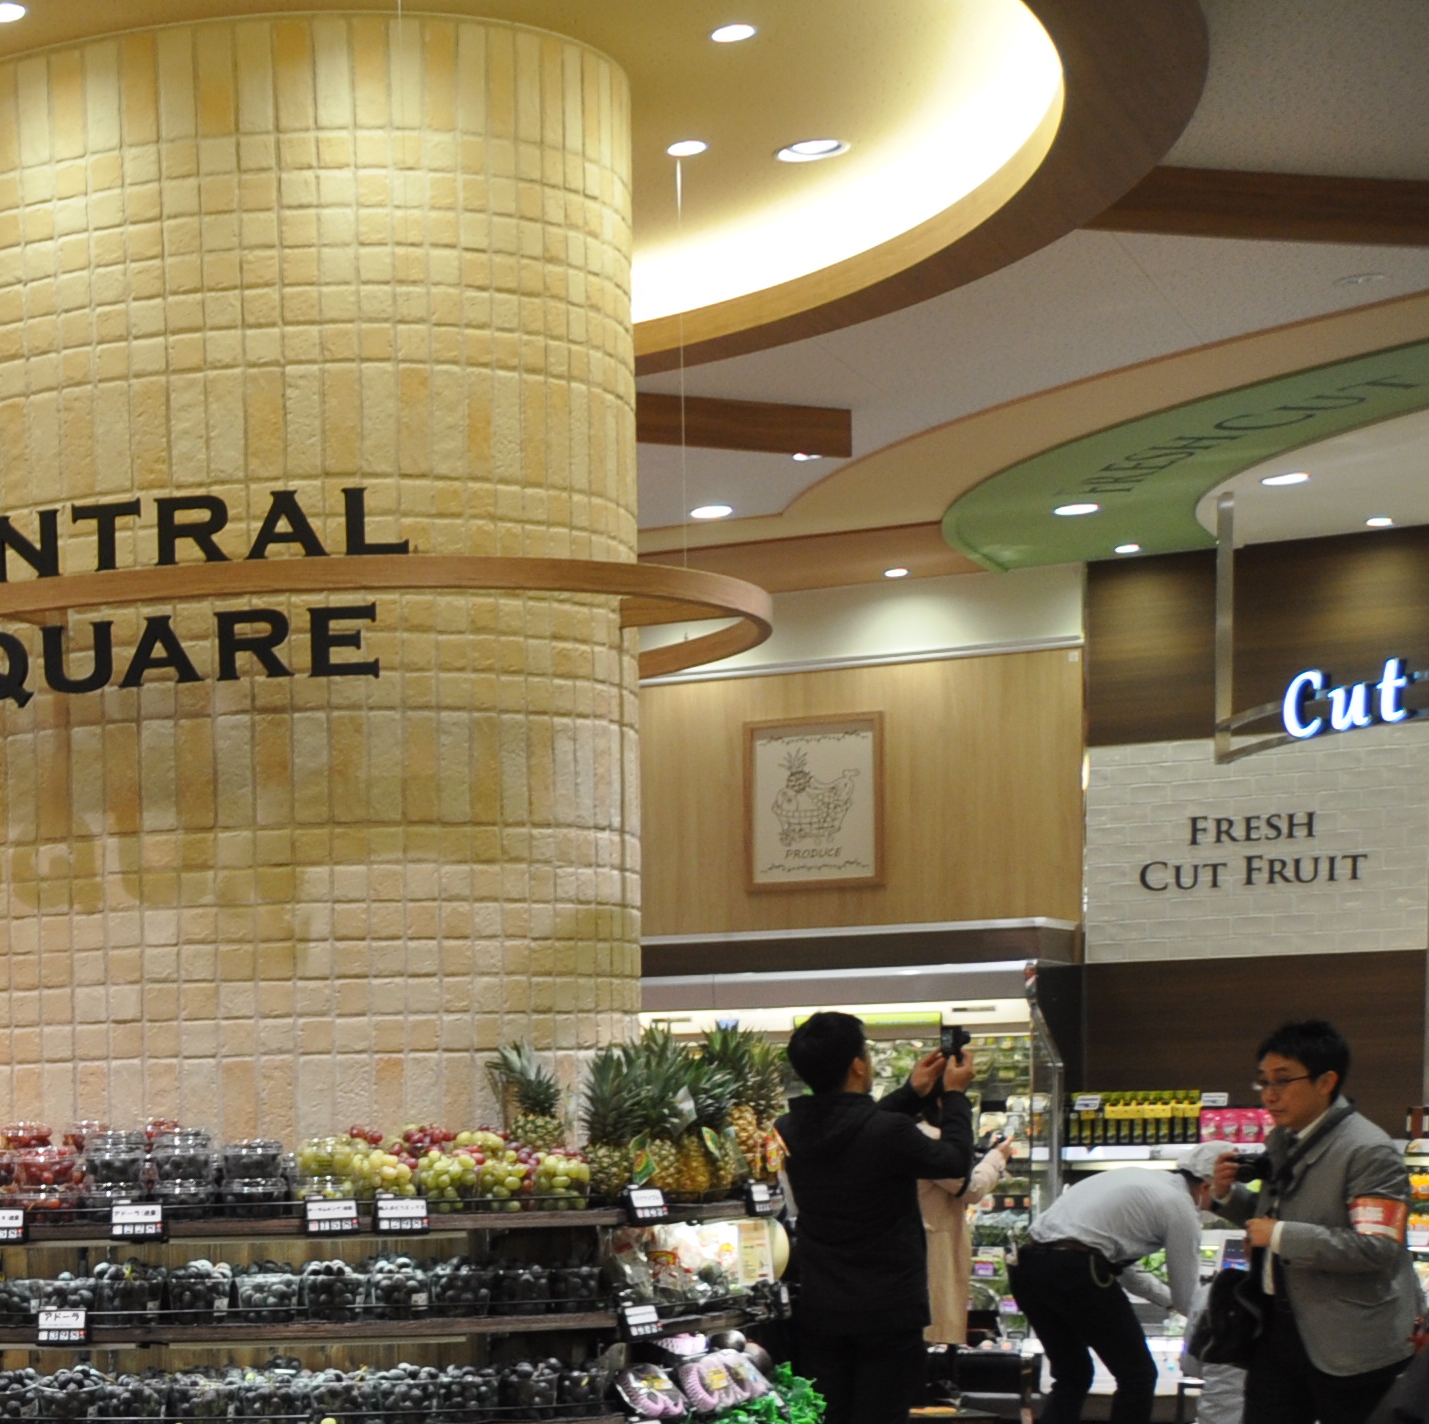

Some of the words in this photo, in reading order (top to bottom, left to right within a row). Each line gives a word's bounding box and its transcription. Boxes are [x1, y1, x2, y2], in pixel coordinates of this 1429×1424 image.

[1214, 374, 1421, 431] CUT
[1283, 656, 1414, 740] Cut
[1189, 811, 1317, 847] FRESH
[785, 847, 842, 859] PRODUCE
[1140, 860, 1227, 892] CUT
[1242, 853, 1368, 887] FRUIT
[44, 1313, 79, 1321] アドーラ
